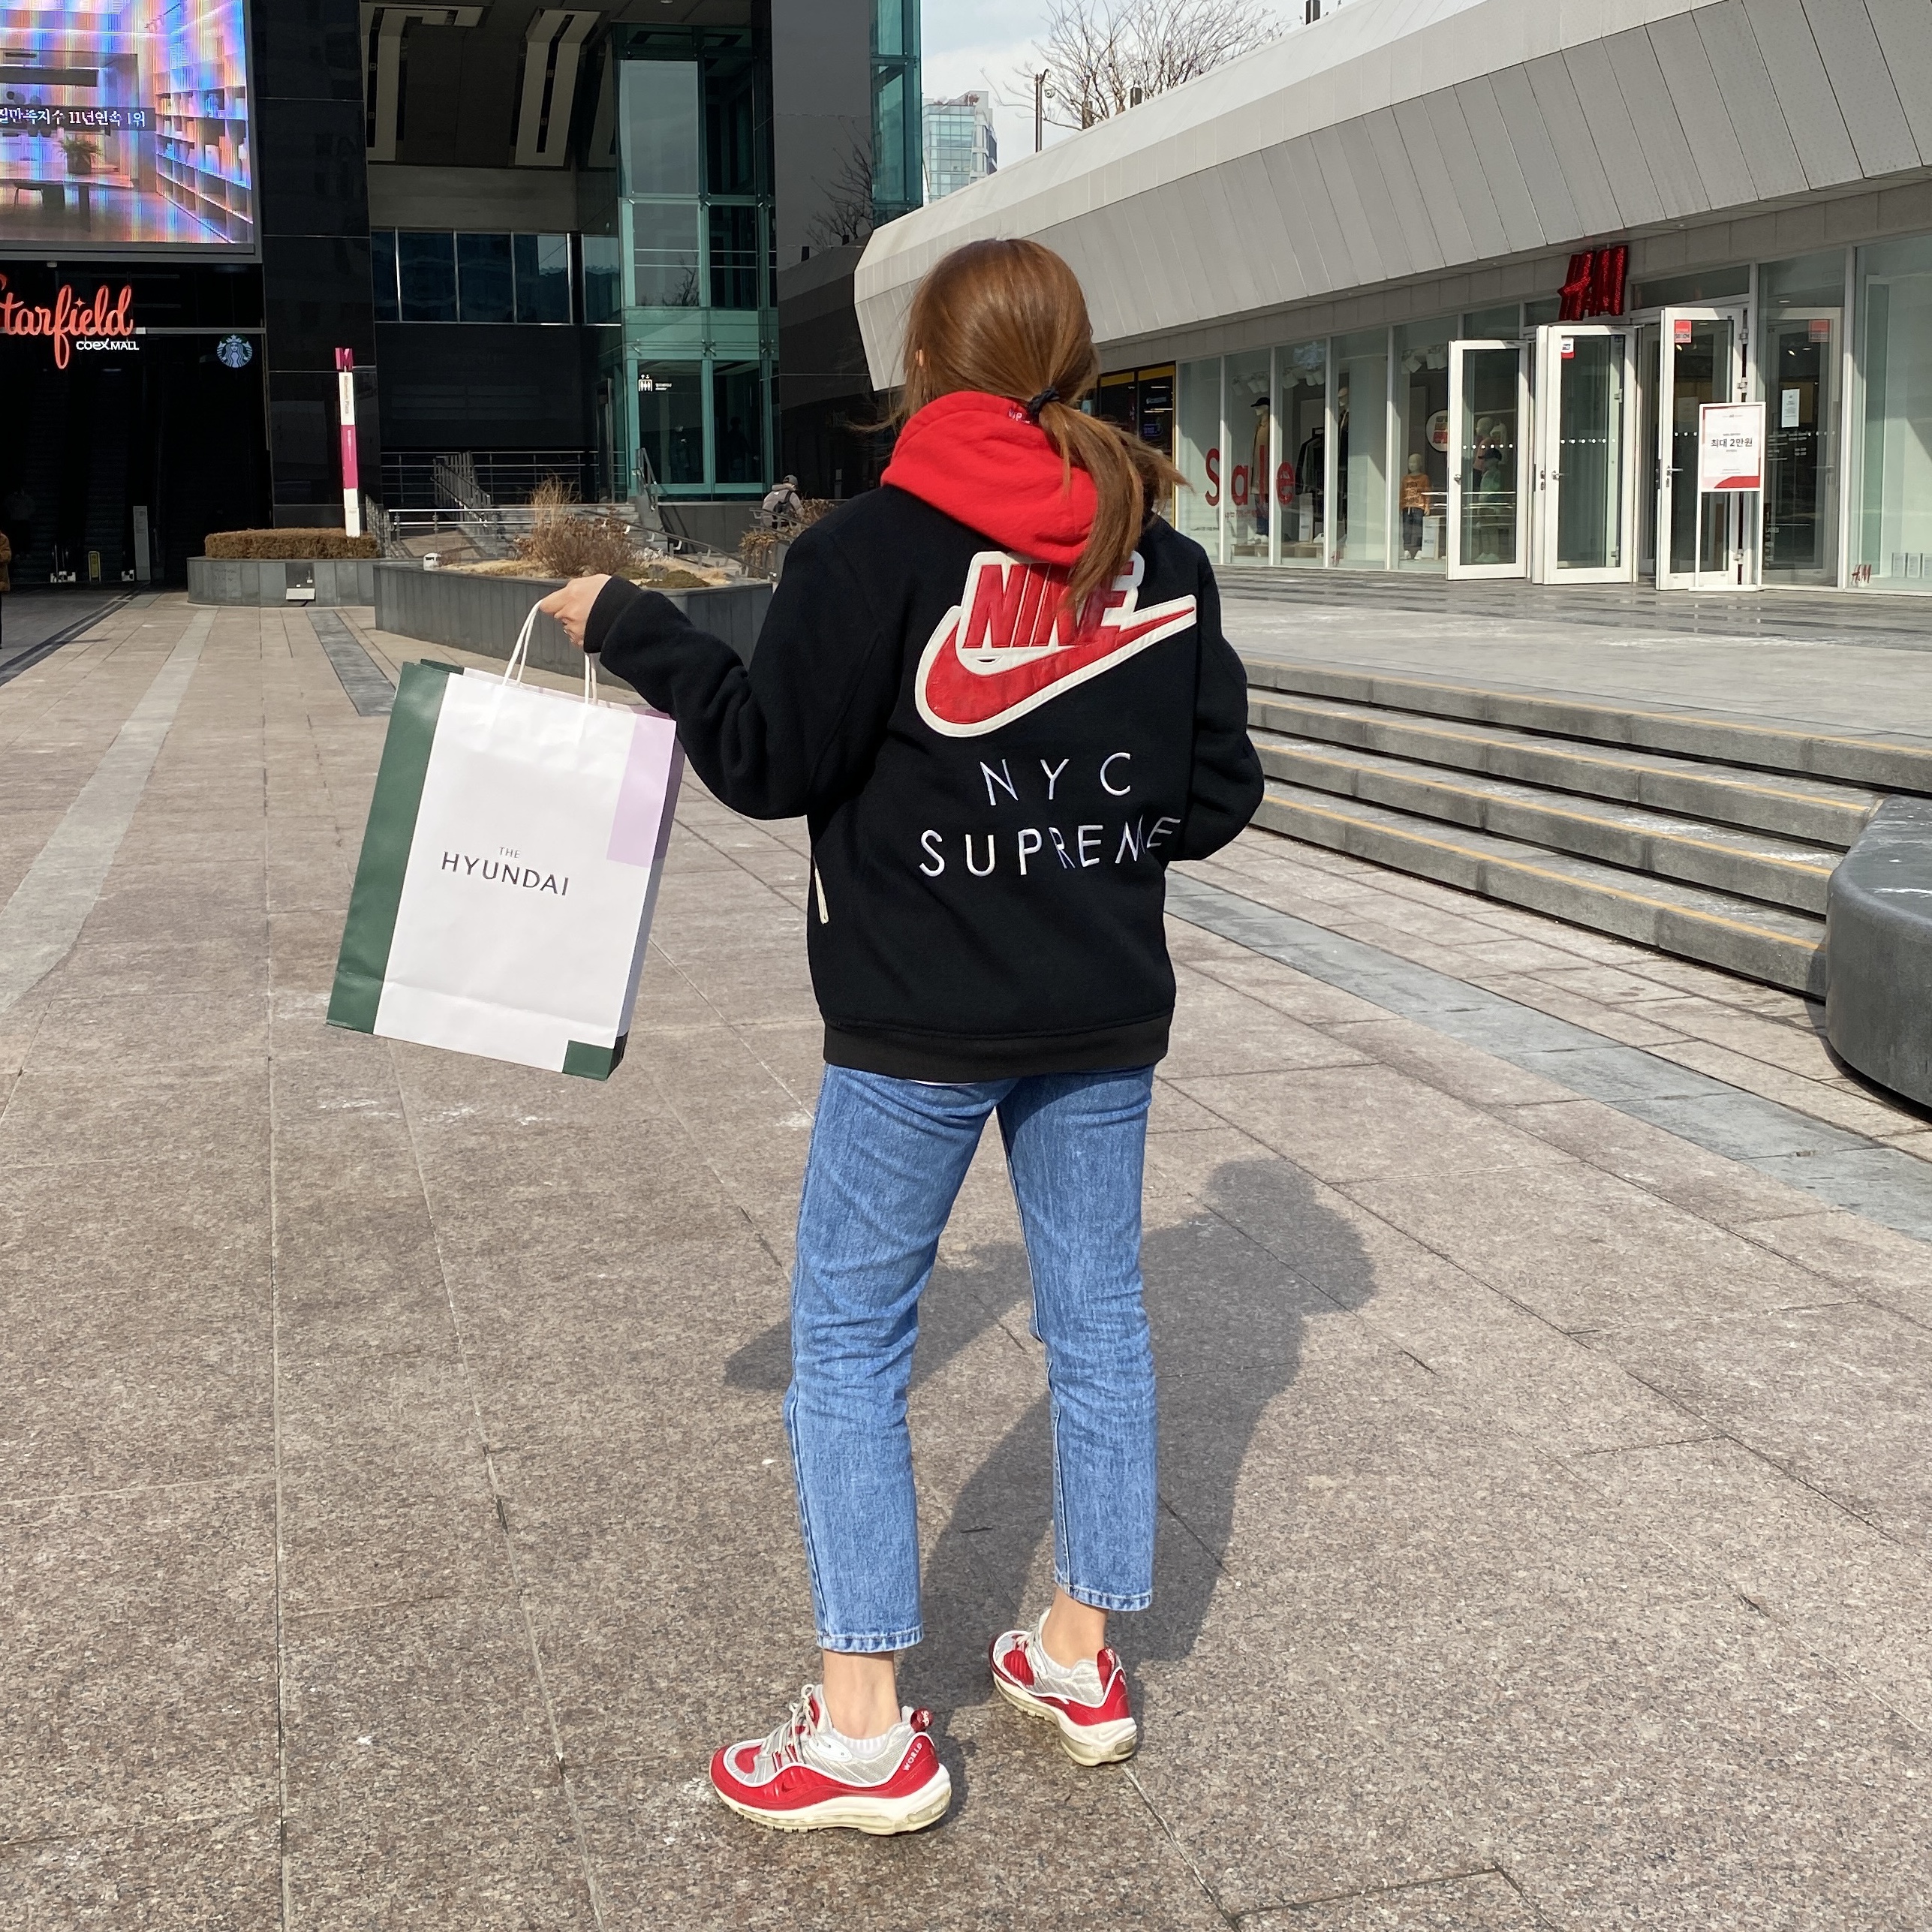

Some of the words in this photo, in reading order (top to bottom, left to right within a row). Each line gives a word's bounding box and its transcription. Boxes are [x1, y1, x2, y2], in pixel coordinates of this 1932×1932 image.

[0, 273, 134, 369] tarfield
[335, 348, 354, 371] M
[1711, 438, 1727, 447] 최대
[1729, 437, 1753, 447] 2만원
[1205, 444, 1296, 507] Sale
[961, 561, 1135, 649] NIKE
[498, 846, 521, 859] THE
[919, 814, 1182, 877] SUPREME
[441, 850, 569, 896] HYUNDAI
[902, 1742, 923, 1771] WORLD
